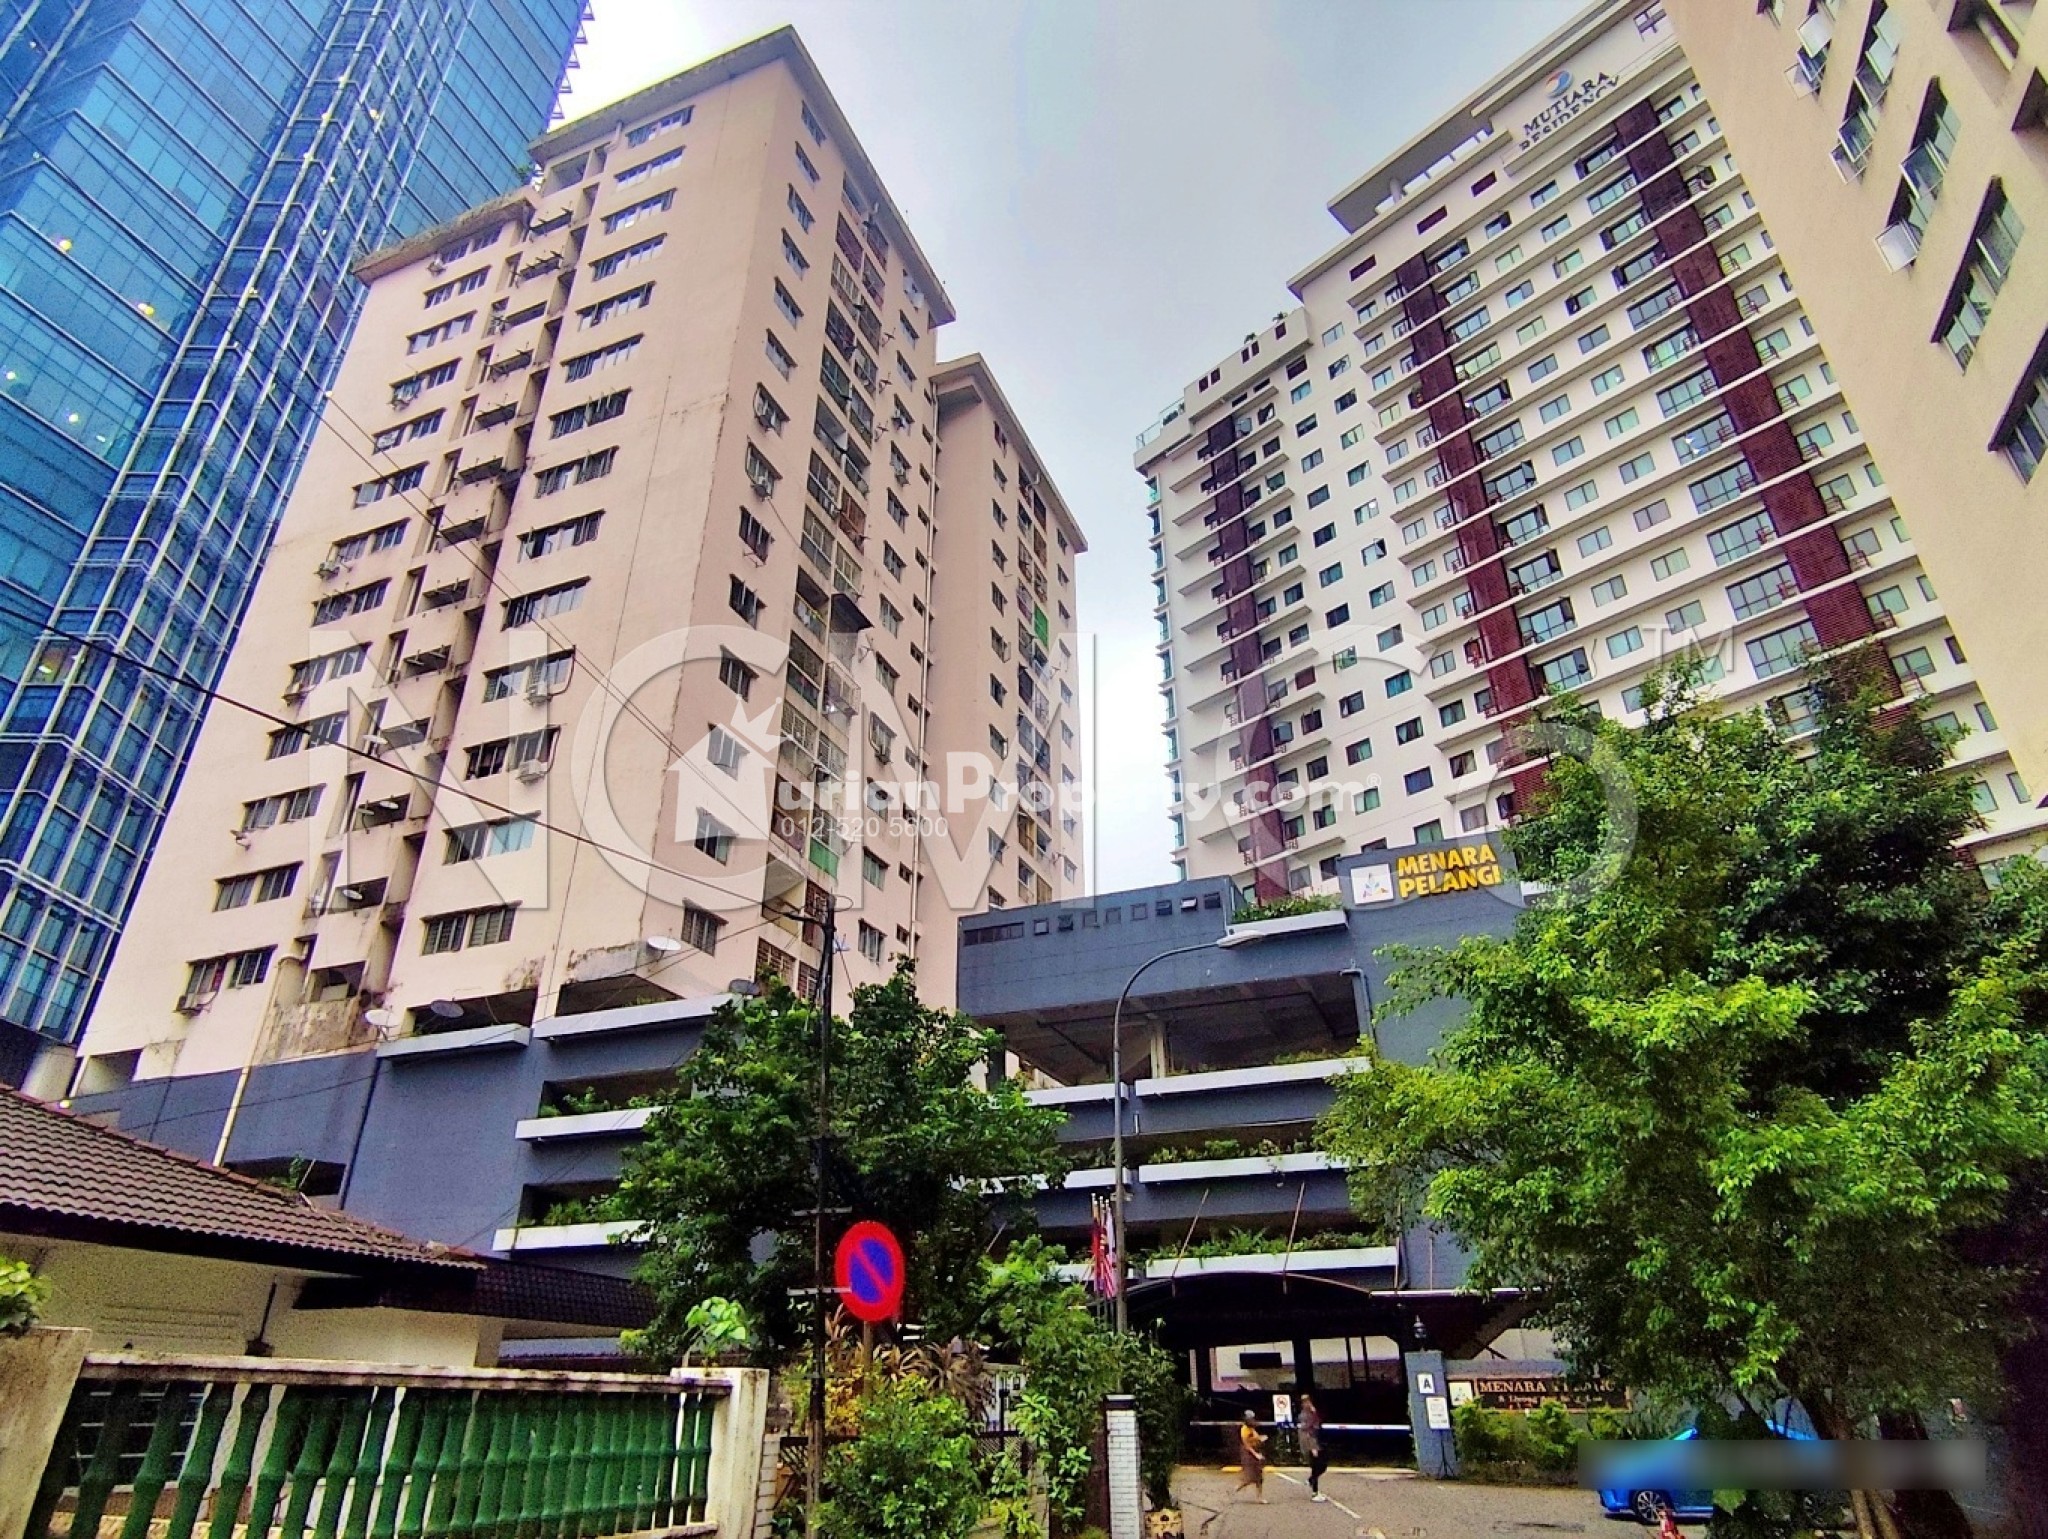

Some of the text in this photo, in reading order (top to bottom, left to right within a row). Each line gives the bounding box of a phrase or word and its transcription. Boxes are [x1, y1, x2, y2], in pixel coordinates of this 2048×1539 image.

[1523, 72, 1610, 136] MUTIARA
[1397, 843, 1497, 877] MENARA
[1398, 864, 1502, 899] PELANGI
[1423, 1377, 1432, 1390] A
[1480, 1380, 1547, 1393] MENARA
